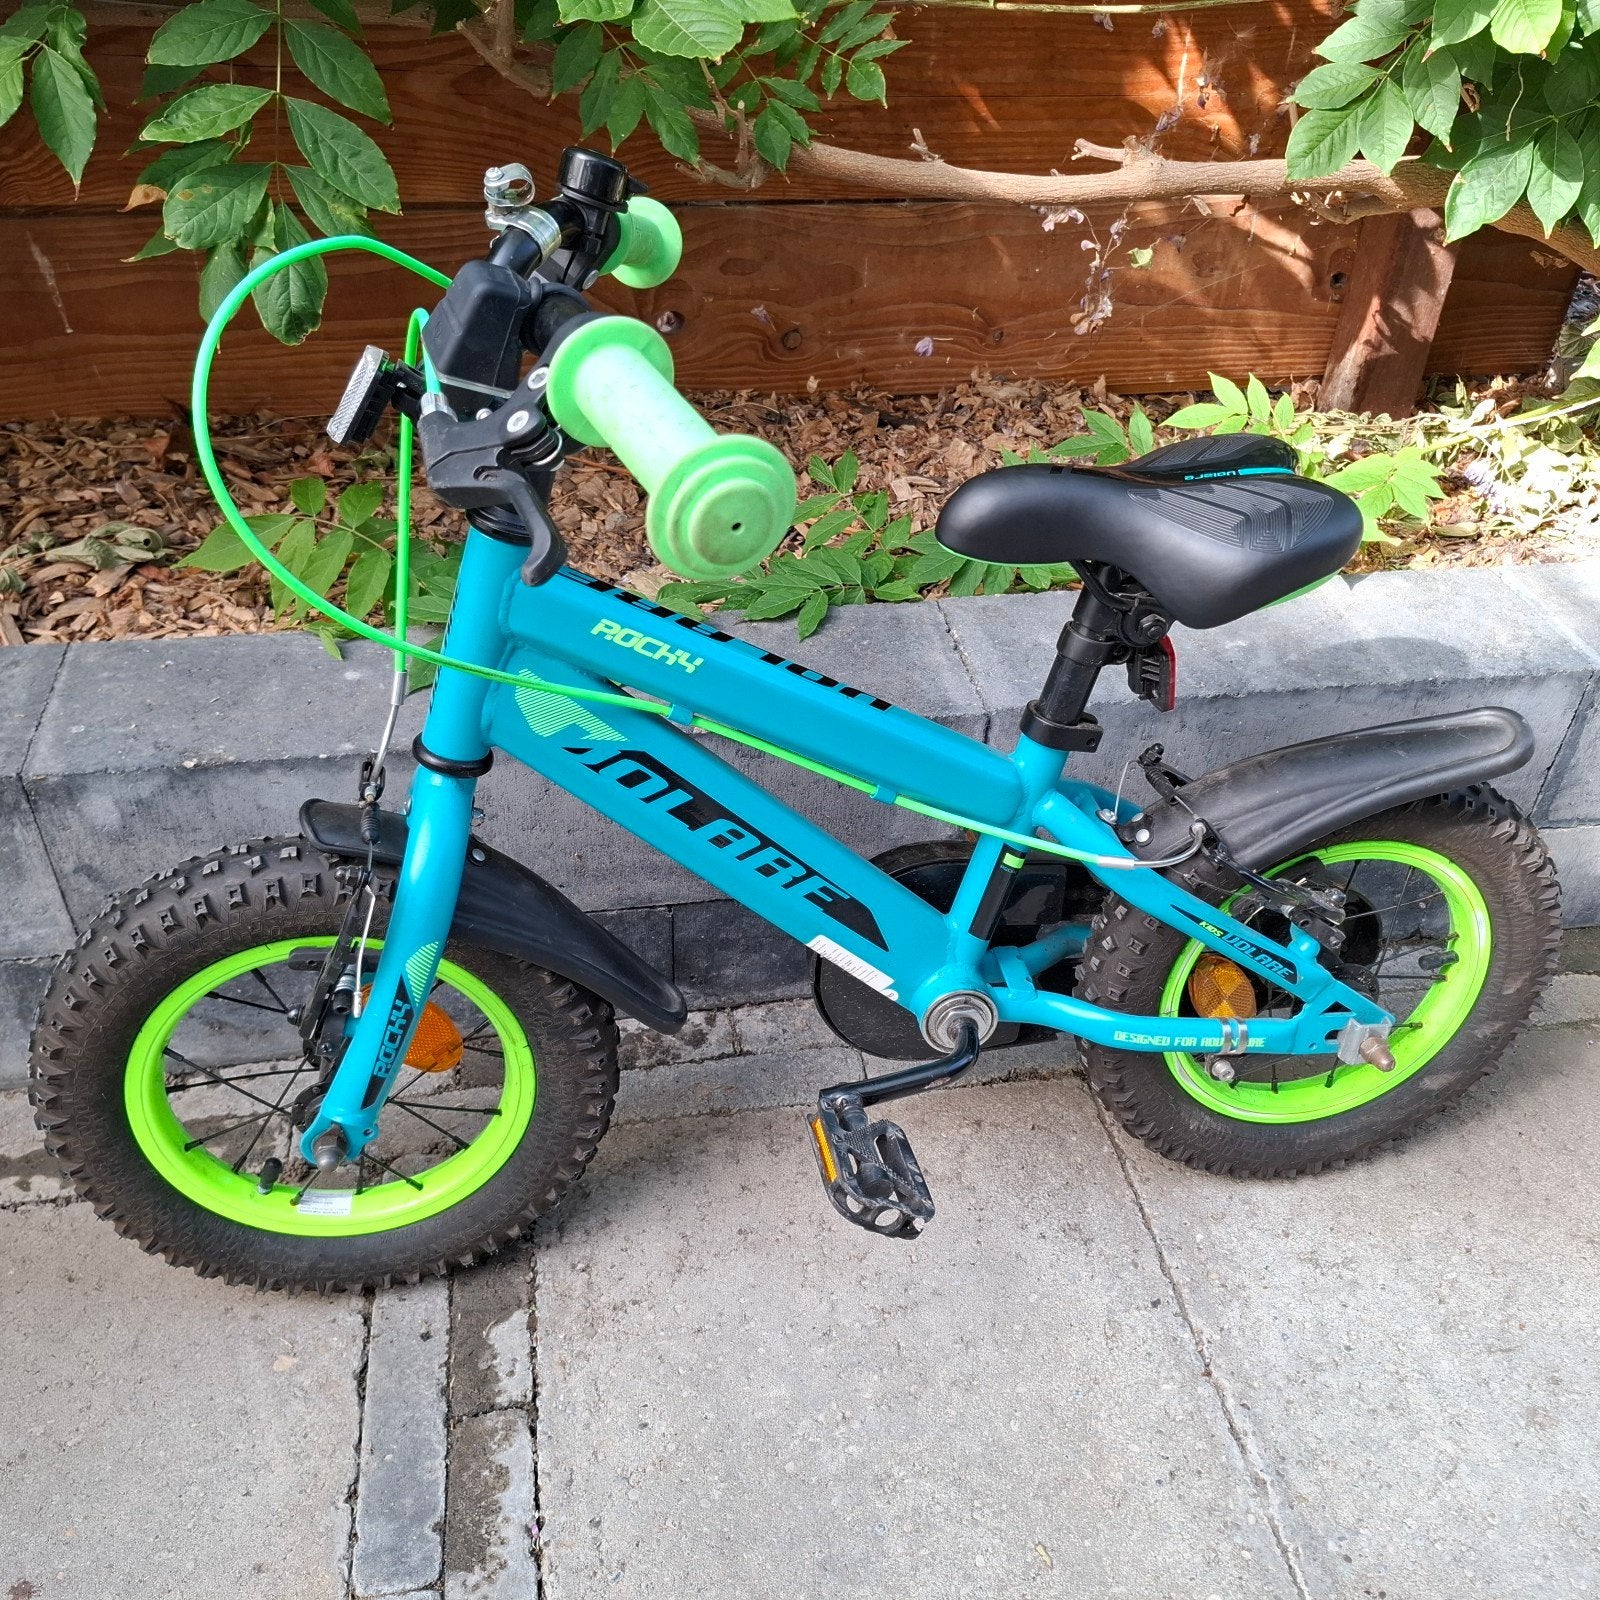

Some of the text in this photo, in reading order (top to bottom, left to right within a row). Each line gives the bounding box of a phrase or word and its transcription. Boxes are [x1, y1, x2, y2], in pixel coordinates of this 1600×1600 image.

[590, 618, 705, 674] ROCKY
[1199, 920, 1295, 979] KIDS VOLARE
[373, 999, 412, 1079] ROCKY
[1113, 1030, 1172, 1047] DESIGNED
[1174, 1036, 1198, 1048] FOR
